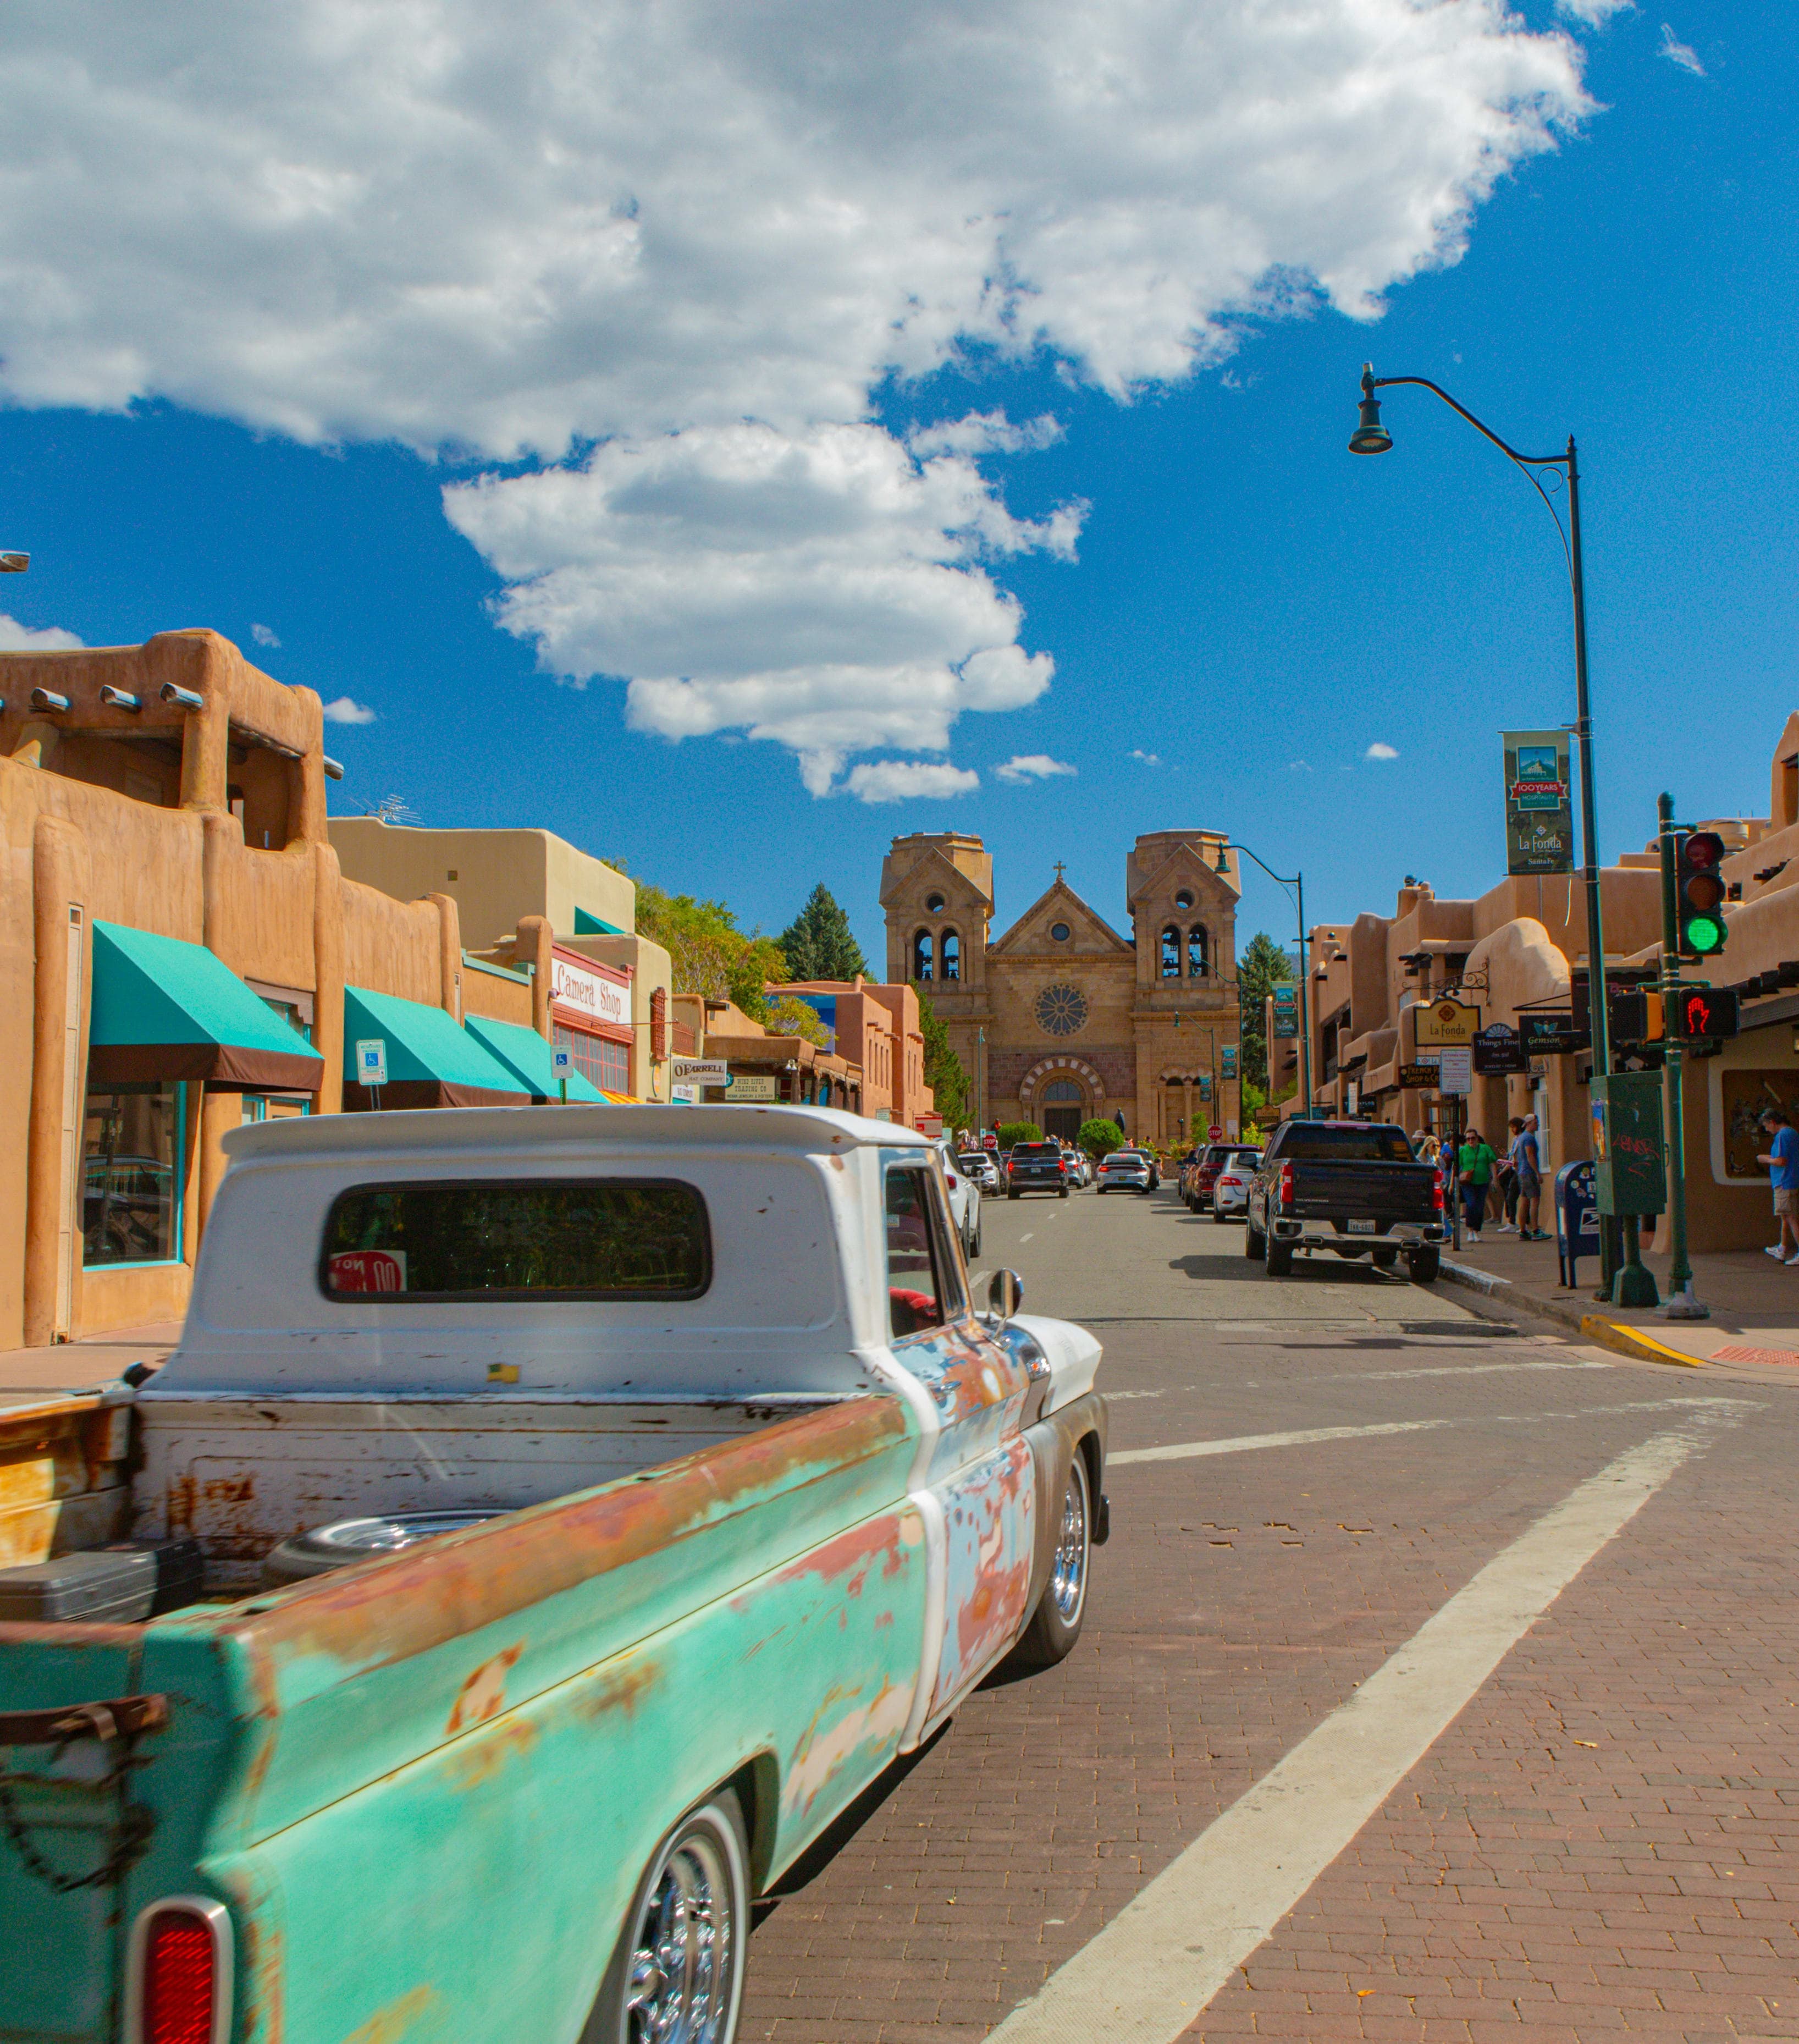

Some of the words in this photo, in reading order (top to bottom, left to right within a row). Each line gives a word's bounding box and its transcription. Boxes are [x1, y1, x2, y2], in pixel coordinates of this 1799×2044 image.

[1519, 835, 1530, 850] La
[1532, 834, 1561, 853] Fonda
[558, 964, 595, 1007] Camera
[600, 983, 621, 1022] Shop
[1430, 1023, 1439, 1035] La
[1441, 1023, 1466, 1038] Fonda
[1477, 1039, 1501, 1048] Things
[675, 1062, 724, 1077] O'FARRELL
